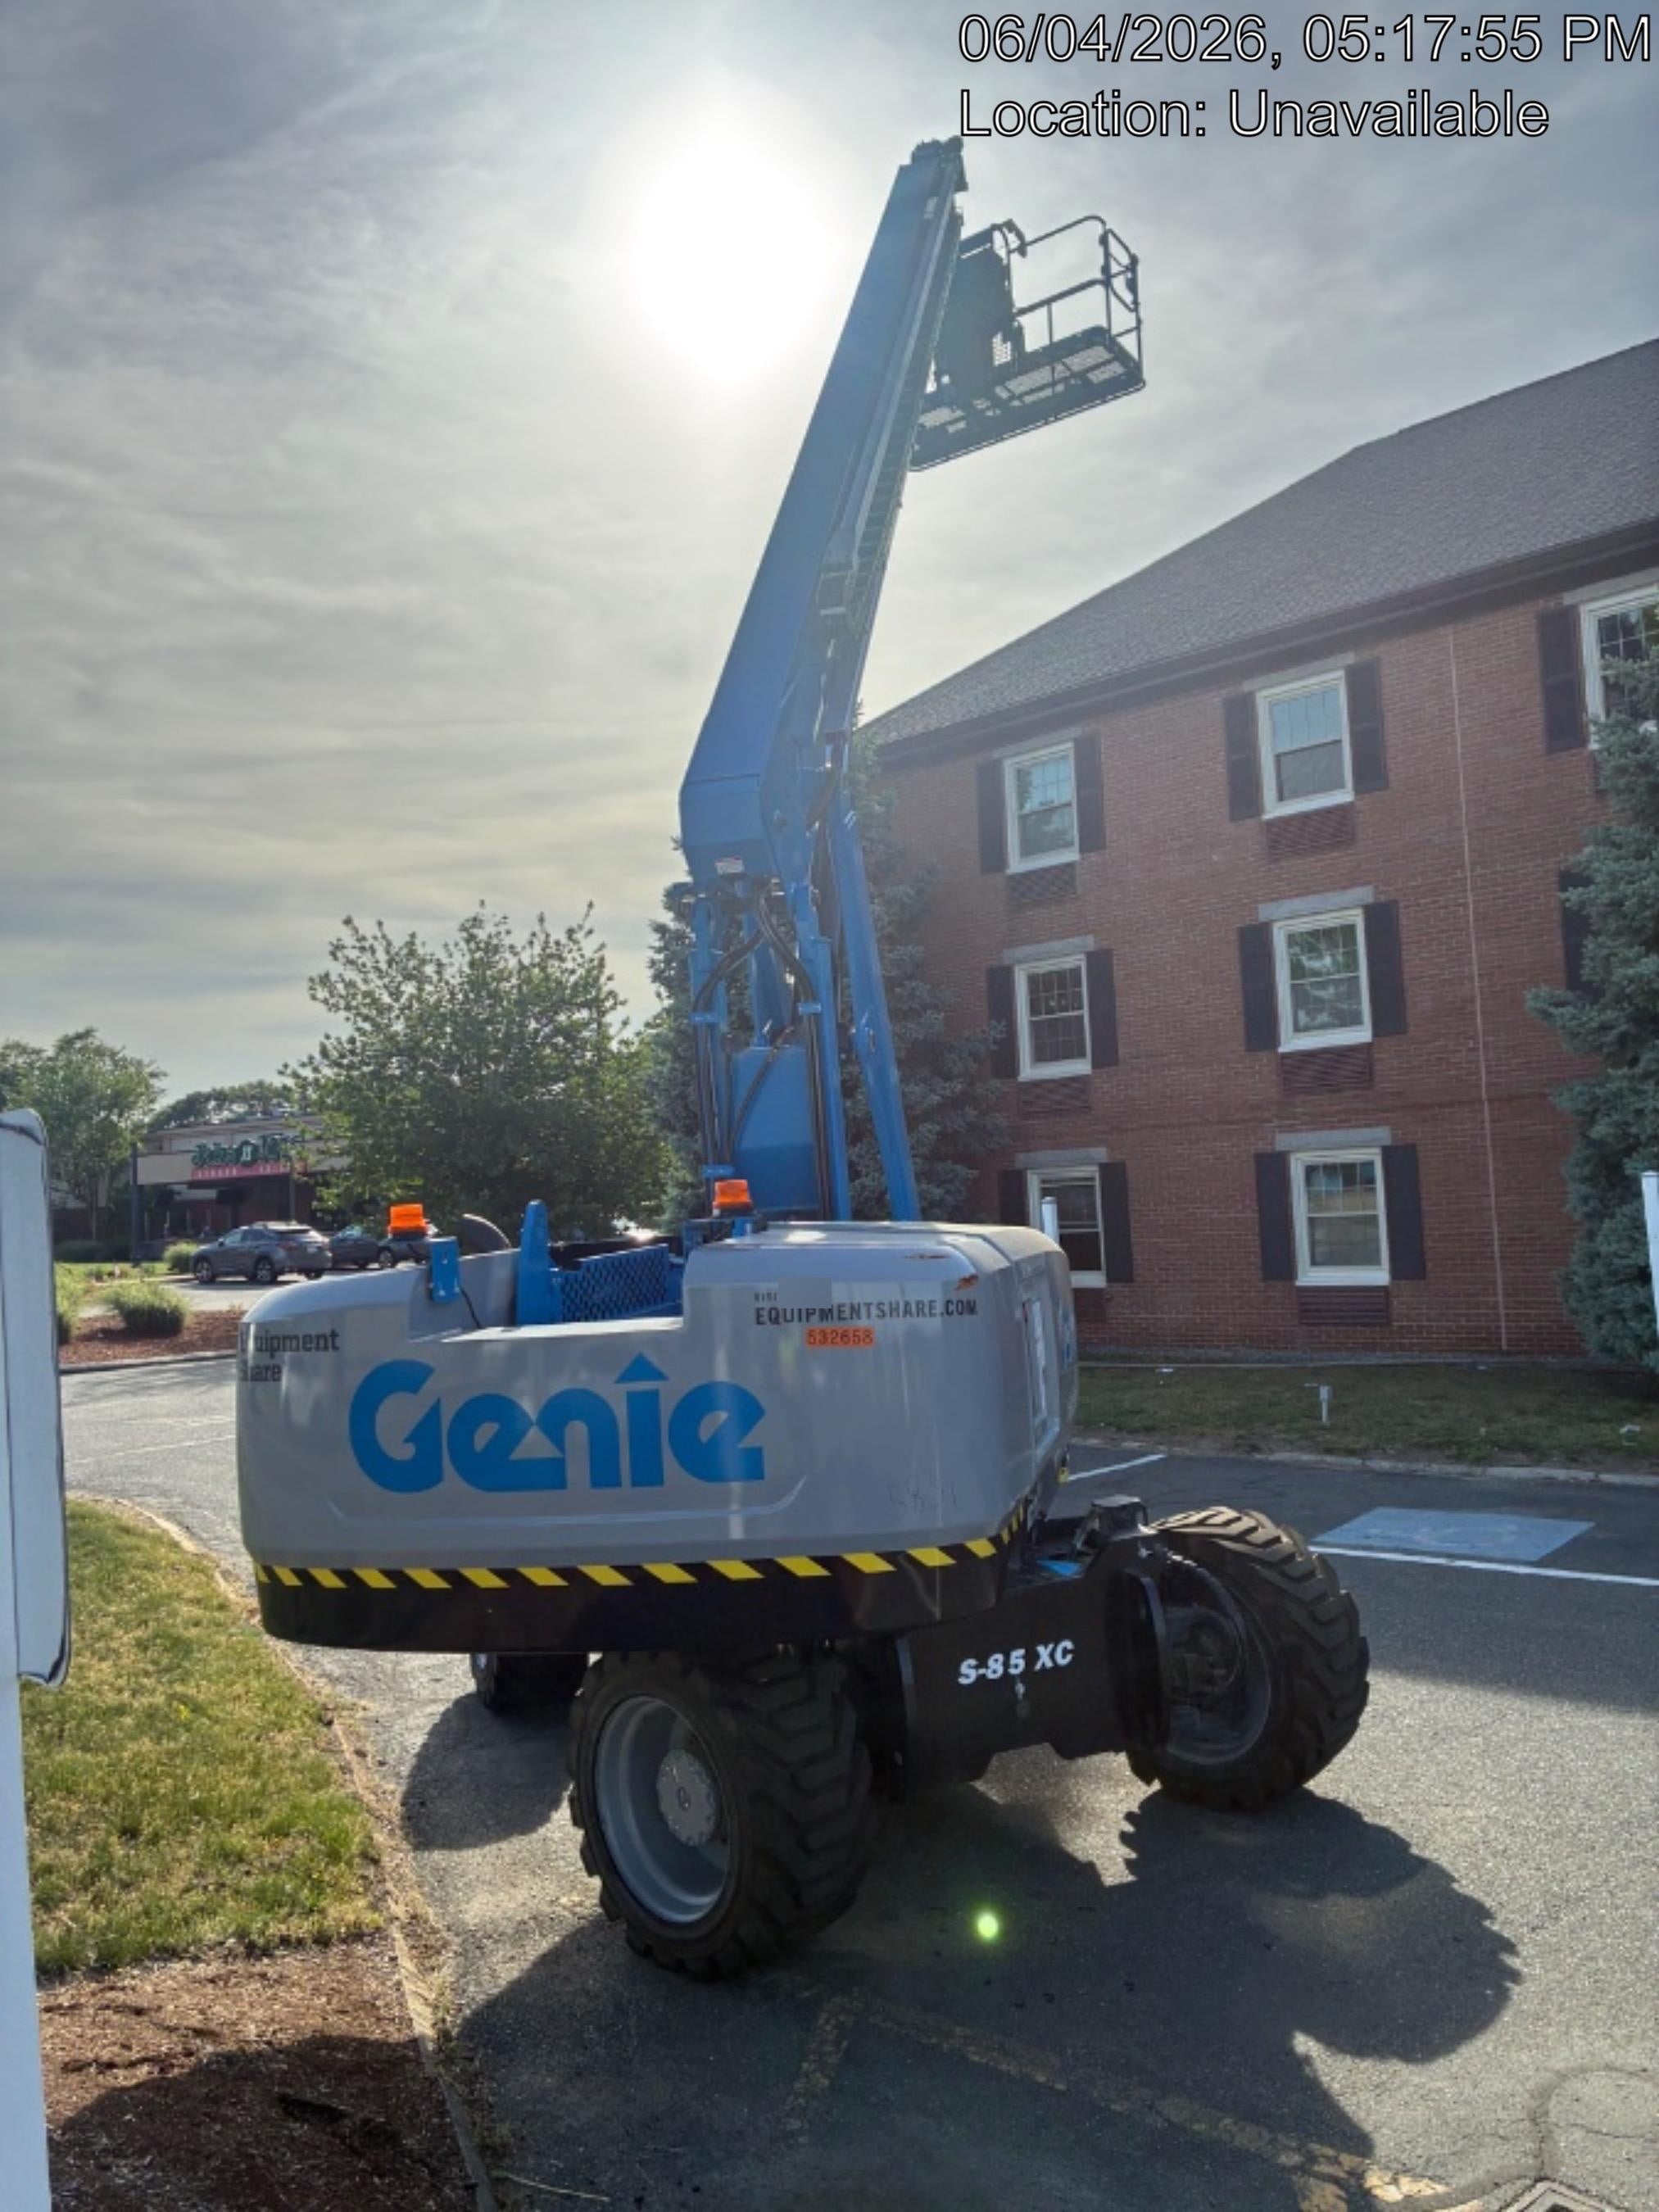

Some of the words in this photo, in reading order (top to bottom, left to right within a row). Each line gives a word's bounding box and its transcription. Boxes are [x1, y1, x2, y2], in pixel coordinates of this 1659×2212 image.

[755, 1299, 977, 1325] EQUIPMENTSHARE.COM
[806, 1329, 873, 1346] 532658
[348, 1352, 766, 1494] Genie
[958, 1648, 1026, 1685] S-85
[1034, 1639, 1075, 1671] XC
